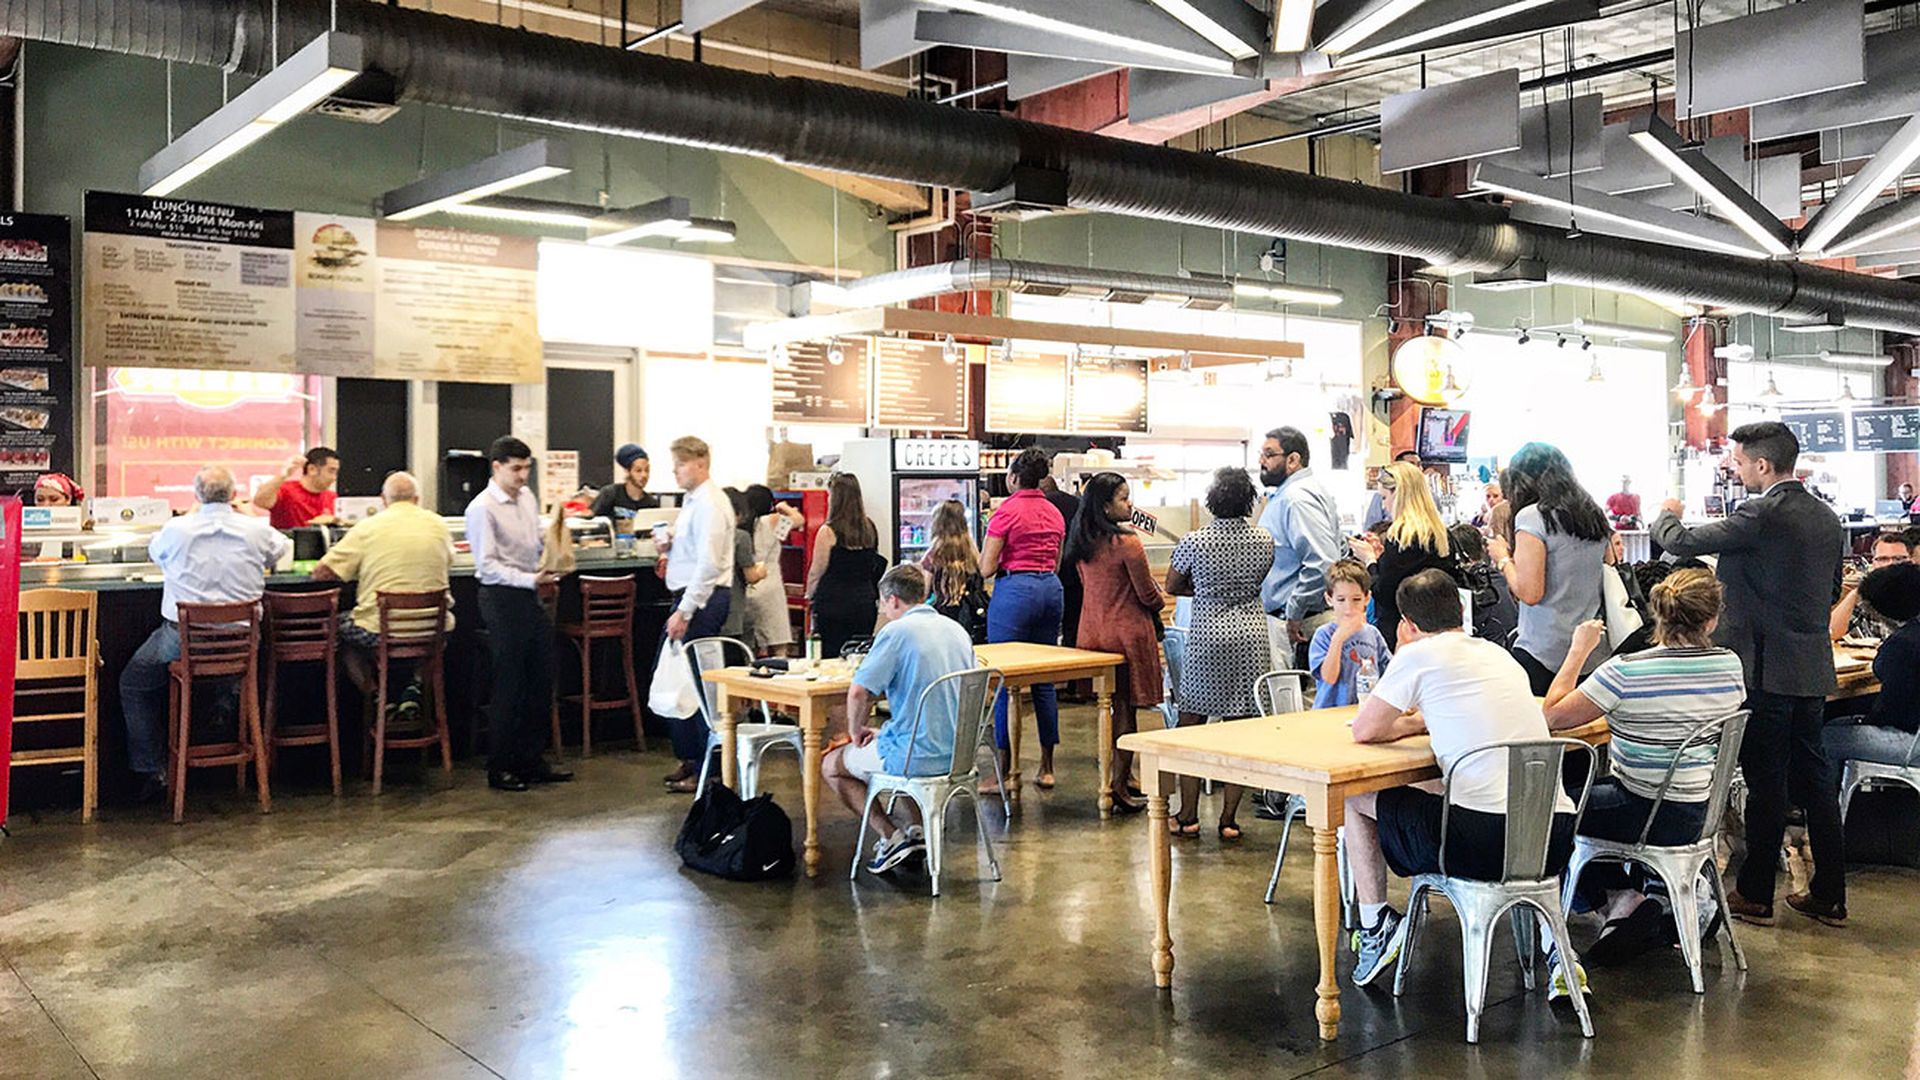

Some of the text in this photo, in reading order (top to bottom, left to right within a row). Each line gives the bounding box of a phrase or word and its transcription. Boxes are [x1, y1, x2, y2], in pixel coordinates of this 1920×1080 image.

[126, 208, 162, 220] 11AM
[218, 217, 264, 230] Mon-Fri
[152, 200, 235, 218] LUNCH MENU
[905, 444, 971, 466] CREPES
[1132, 510, 1156, 533] OPEN
